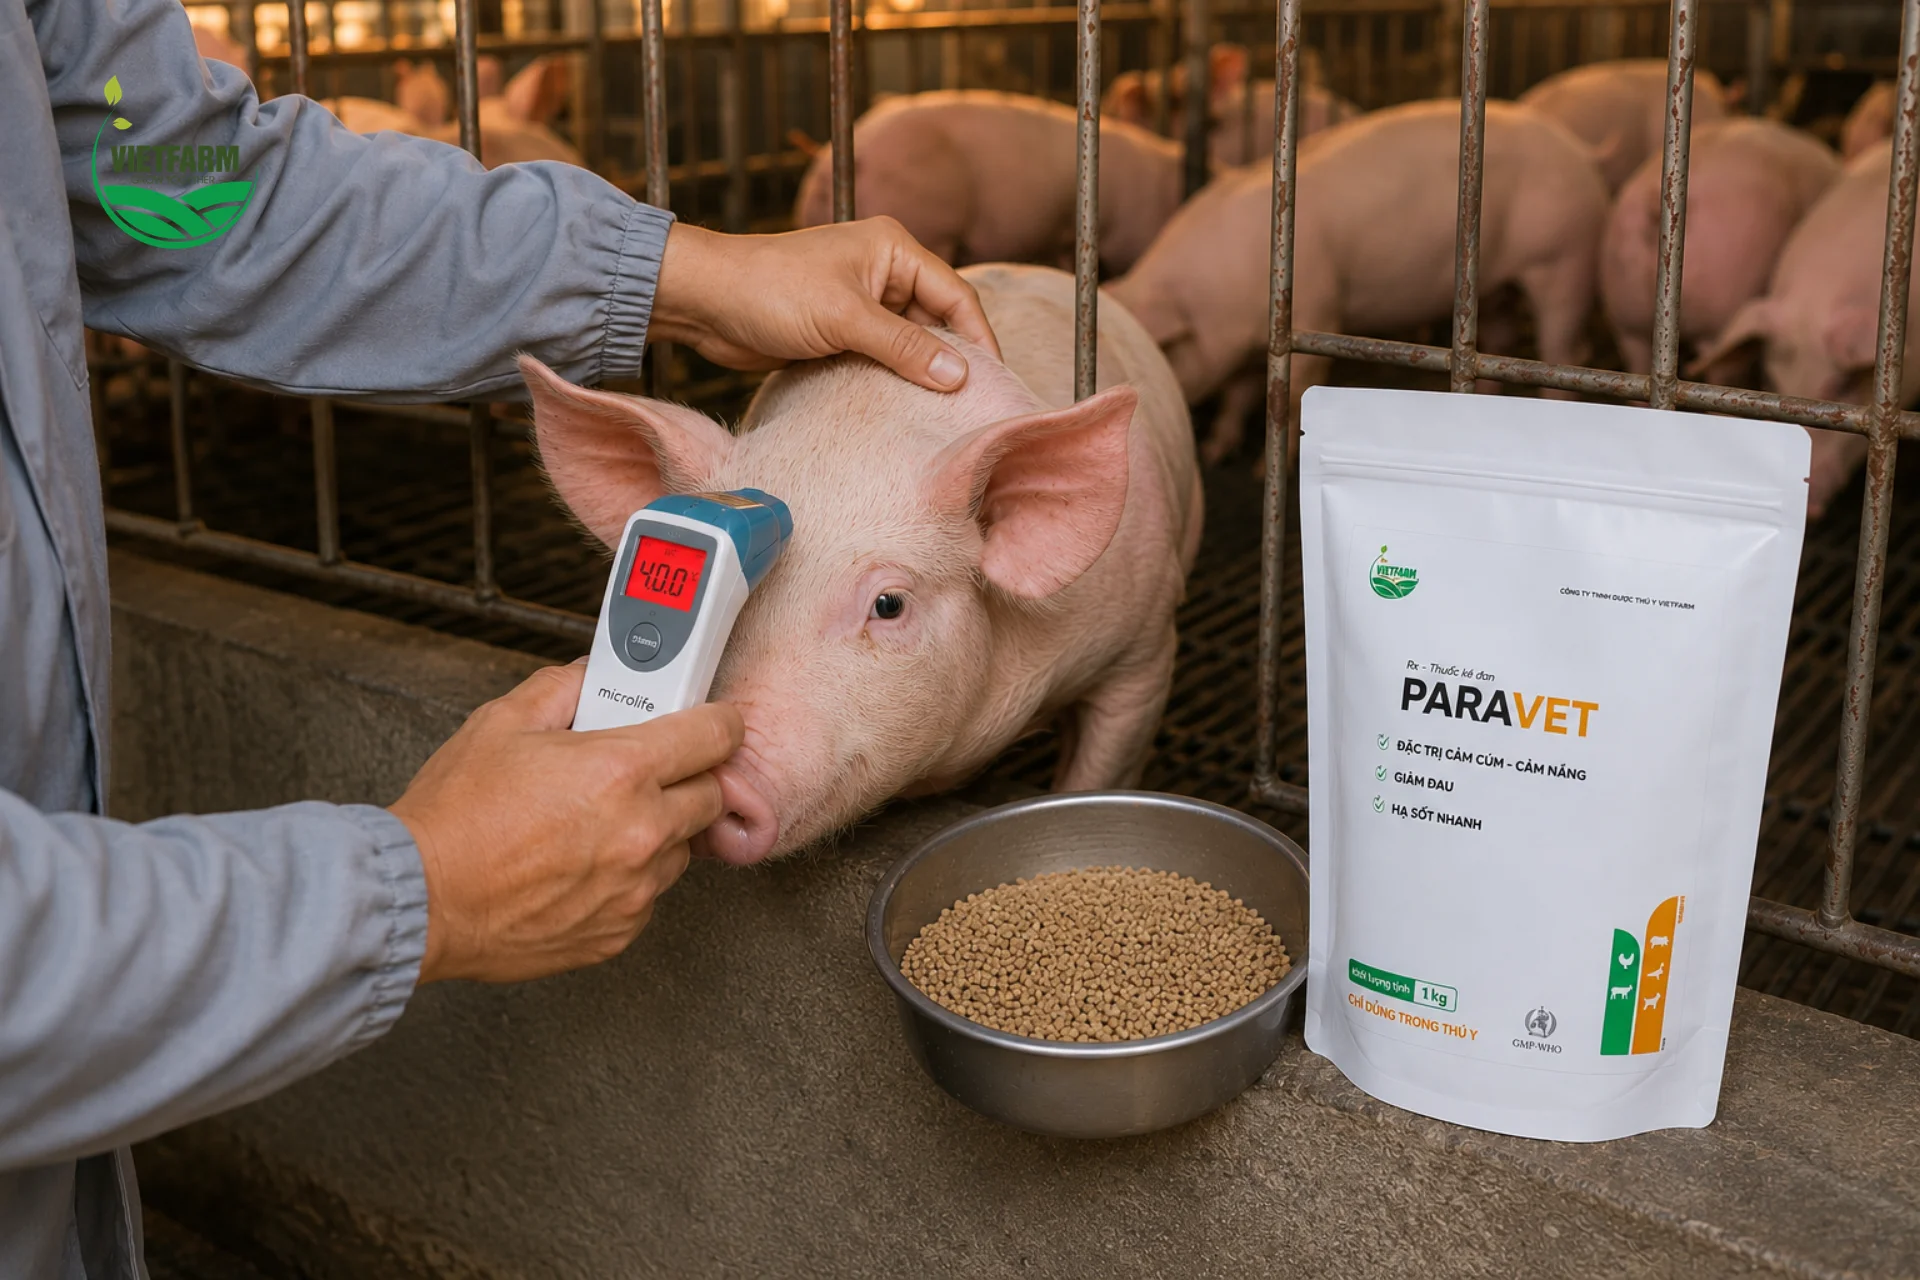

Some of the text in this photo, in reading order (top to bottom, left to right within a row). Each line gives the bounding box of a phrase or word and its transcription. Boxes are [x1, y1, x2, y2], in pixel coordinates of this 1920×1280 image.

[1406, 660, 1419, 671] Rx
[1430, 663, 1460, 677] Thuốc
[598, 687, 655, 712] microlife
[1400, 677, 1600, 738] PARAVET
[1397, 740, 1422, 755] ĐẶC
[1424, 745, 1443, 761] TRỊ
[1475, 752, 1504, 768] CÚM
[1427, 778, 1454, 792] ĐAU
[1391, 803, 1482, 830] HẠ SỐT NHANH
[1398, 1011, 1439, 1032] TRONG
[1469, 1029, 1478, 1040] Y
[1512, 1039, 1562, 1054] GMP-WHO
